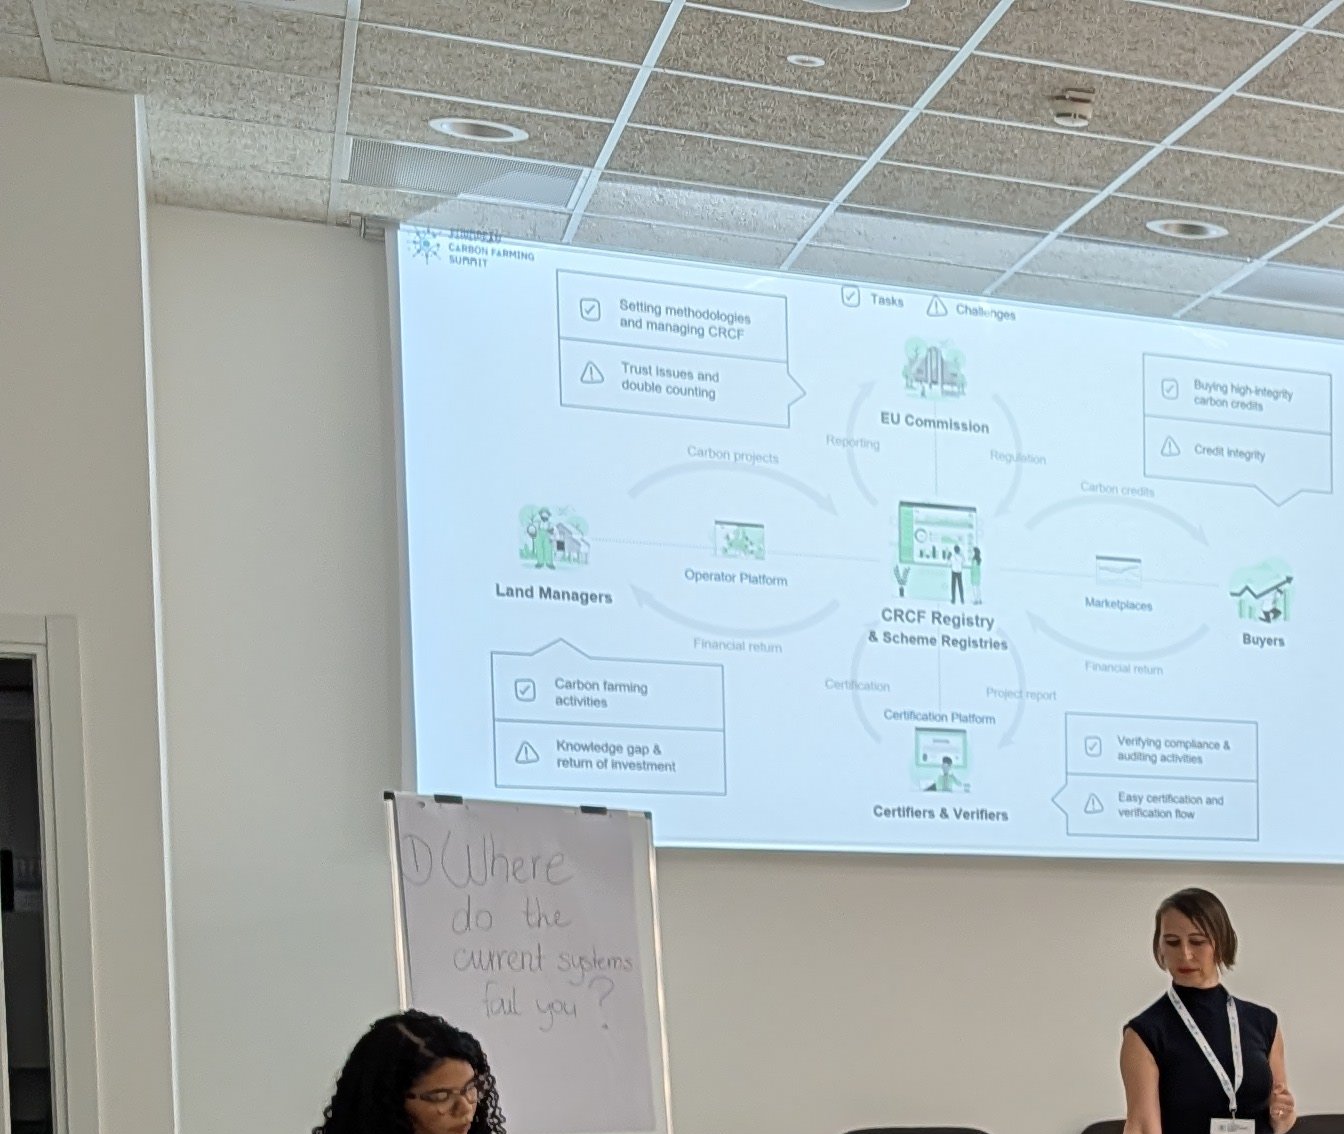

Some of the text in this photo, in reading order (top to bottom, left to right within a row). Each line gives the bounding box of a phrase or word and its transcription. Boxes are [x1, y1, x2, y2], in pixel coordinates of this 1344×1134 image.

[870, 292, 904, 308] Tasks
[619, 299, 751, 325] Setting methodologies
[956, 303, 1016, 322] Challenges
[620, 316, 744, 340] and managing CRCF
[622, 362, 719, 383] Trust issues and
[621, 378, 716, 401] double counting
[1194, 378, 1228, 396] Buying
[1194, 395, 1263, 412] carbon credits
[881, 412, 990, 434] EU Commission
[826, 434, 880, 452] Reporting
[687, 445, 779, 465] Carbon projects
[990, 450, 1047, 466] Regulation
[1194, 444, 1266, 463] Credit integrity
[1081, 480, 1155, 498] Carbon credits
[685, 568, 787, 587] Operator Platform
[496, 583, 613, 605] Land Managers
[1085, 597, 1153, 613] Marketplaces
[881, 608, 995, 632] CRCF Registry
[694, 638, 782, 654] Financial return
[868, 630, 1008, 653] & Scheme Registries
[1243, 632, 1285, 650] Buyers
[1085, 661, 1163, 677] Financial return
[555, 678, 648, 696] Carbon farming
[825, 678, 890, 693] Certification
[986, 686, 1057, 703] Project report
[555, 695, 608, 709] activities
[884, 709, 996, 728] Certification Platform
[556, 740, 662, 758] Knowledge gap &
[1118, 735, 1230, 755] Verifying compliance &
[557, 757, 676, 774] return of investment
[1118, 751, 1203, 766] auditing activities
[1118, 792, 1224, 808] Easy certification and
[873, 804, 1008, 824] Certifiers & Verifiers
[1118, 807, 1196, 822] verification flow
[442, 831, 573, 888] Where
[452, 895, 571, 934] do the
[454, 943, 634, 986] current systems
[536, 999, 577, 1032] you
